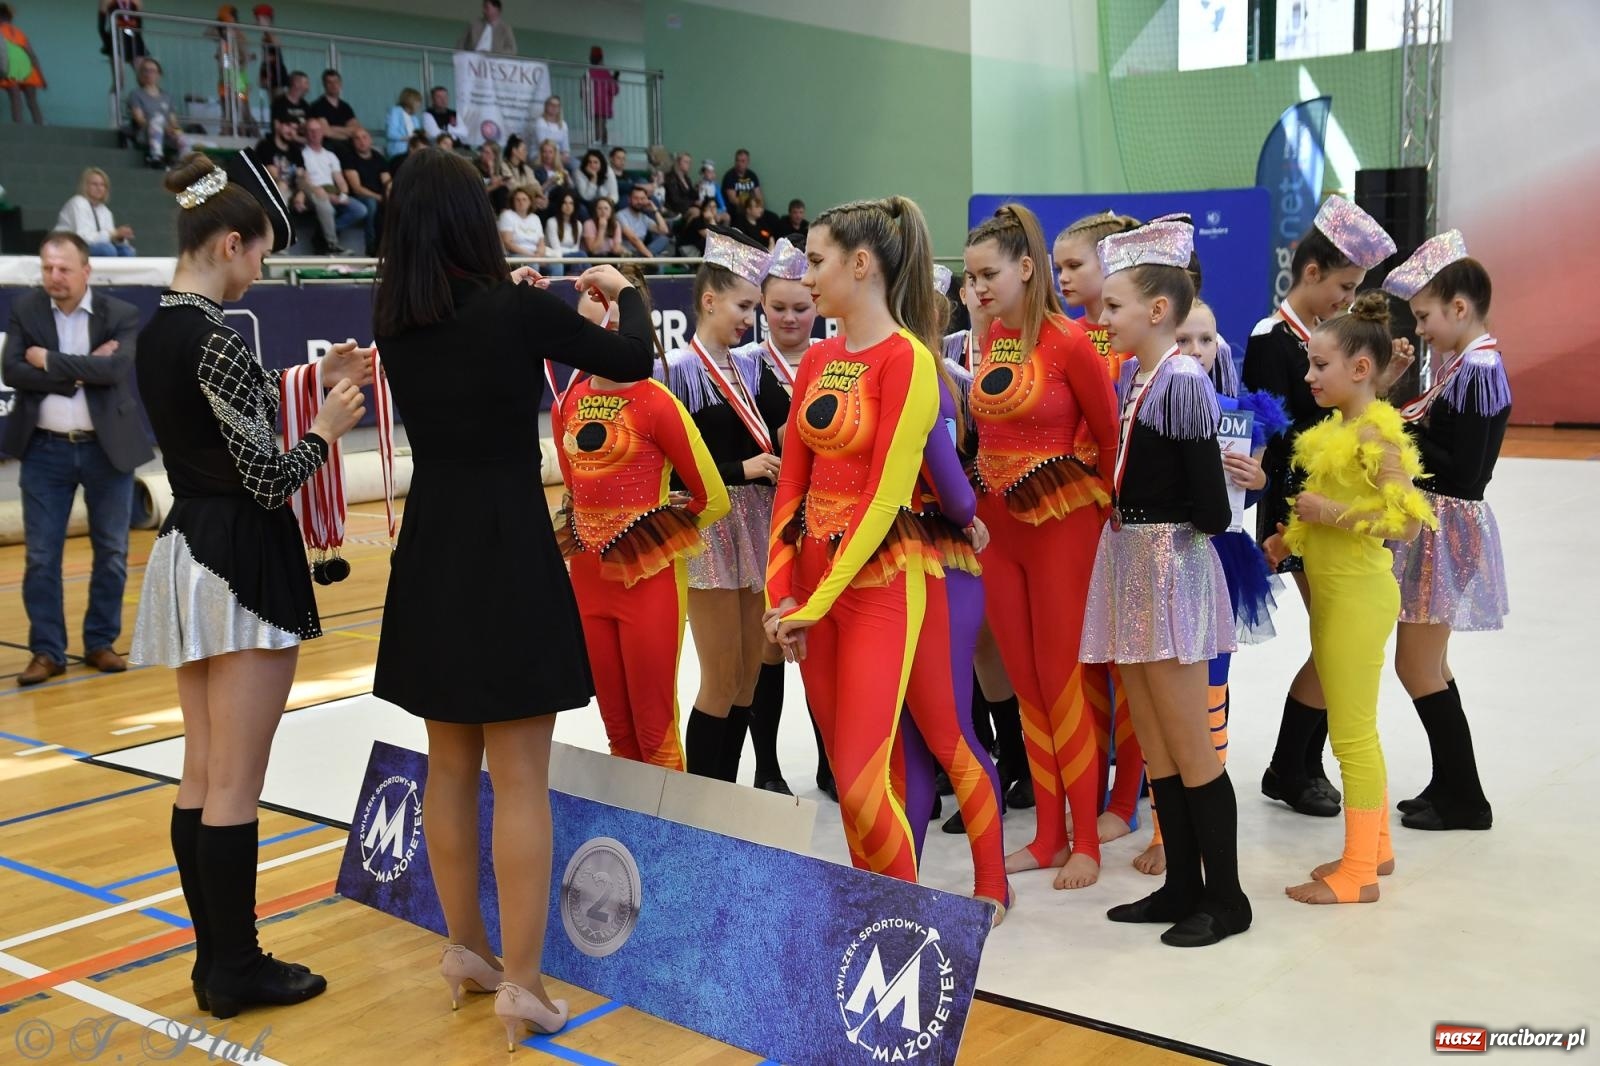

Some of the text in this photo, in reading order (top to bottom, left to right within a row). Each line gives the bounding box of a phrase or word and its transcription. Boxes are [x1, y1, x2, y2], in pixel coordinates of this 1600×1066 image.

[822, 360, 870, 378] LOONEY
[819, 375, 857, 392] TUNES
[577, 395, 630, 411] LOONEY
[578, 407, 619, 420] TUNES
[375, 802, 422, 882] MAŻORETEK
[859, 918, 922, 942] SPORTOWY
[872, 958, 954, 1062] MAŻORETEK
